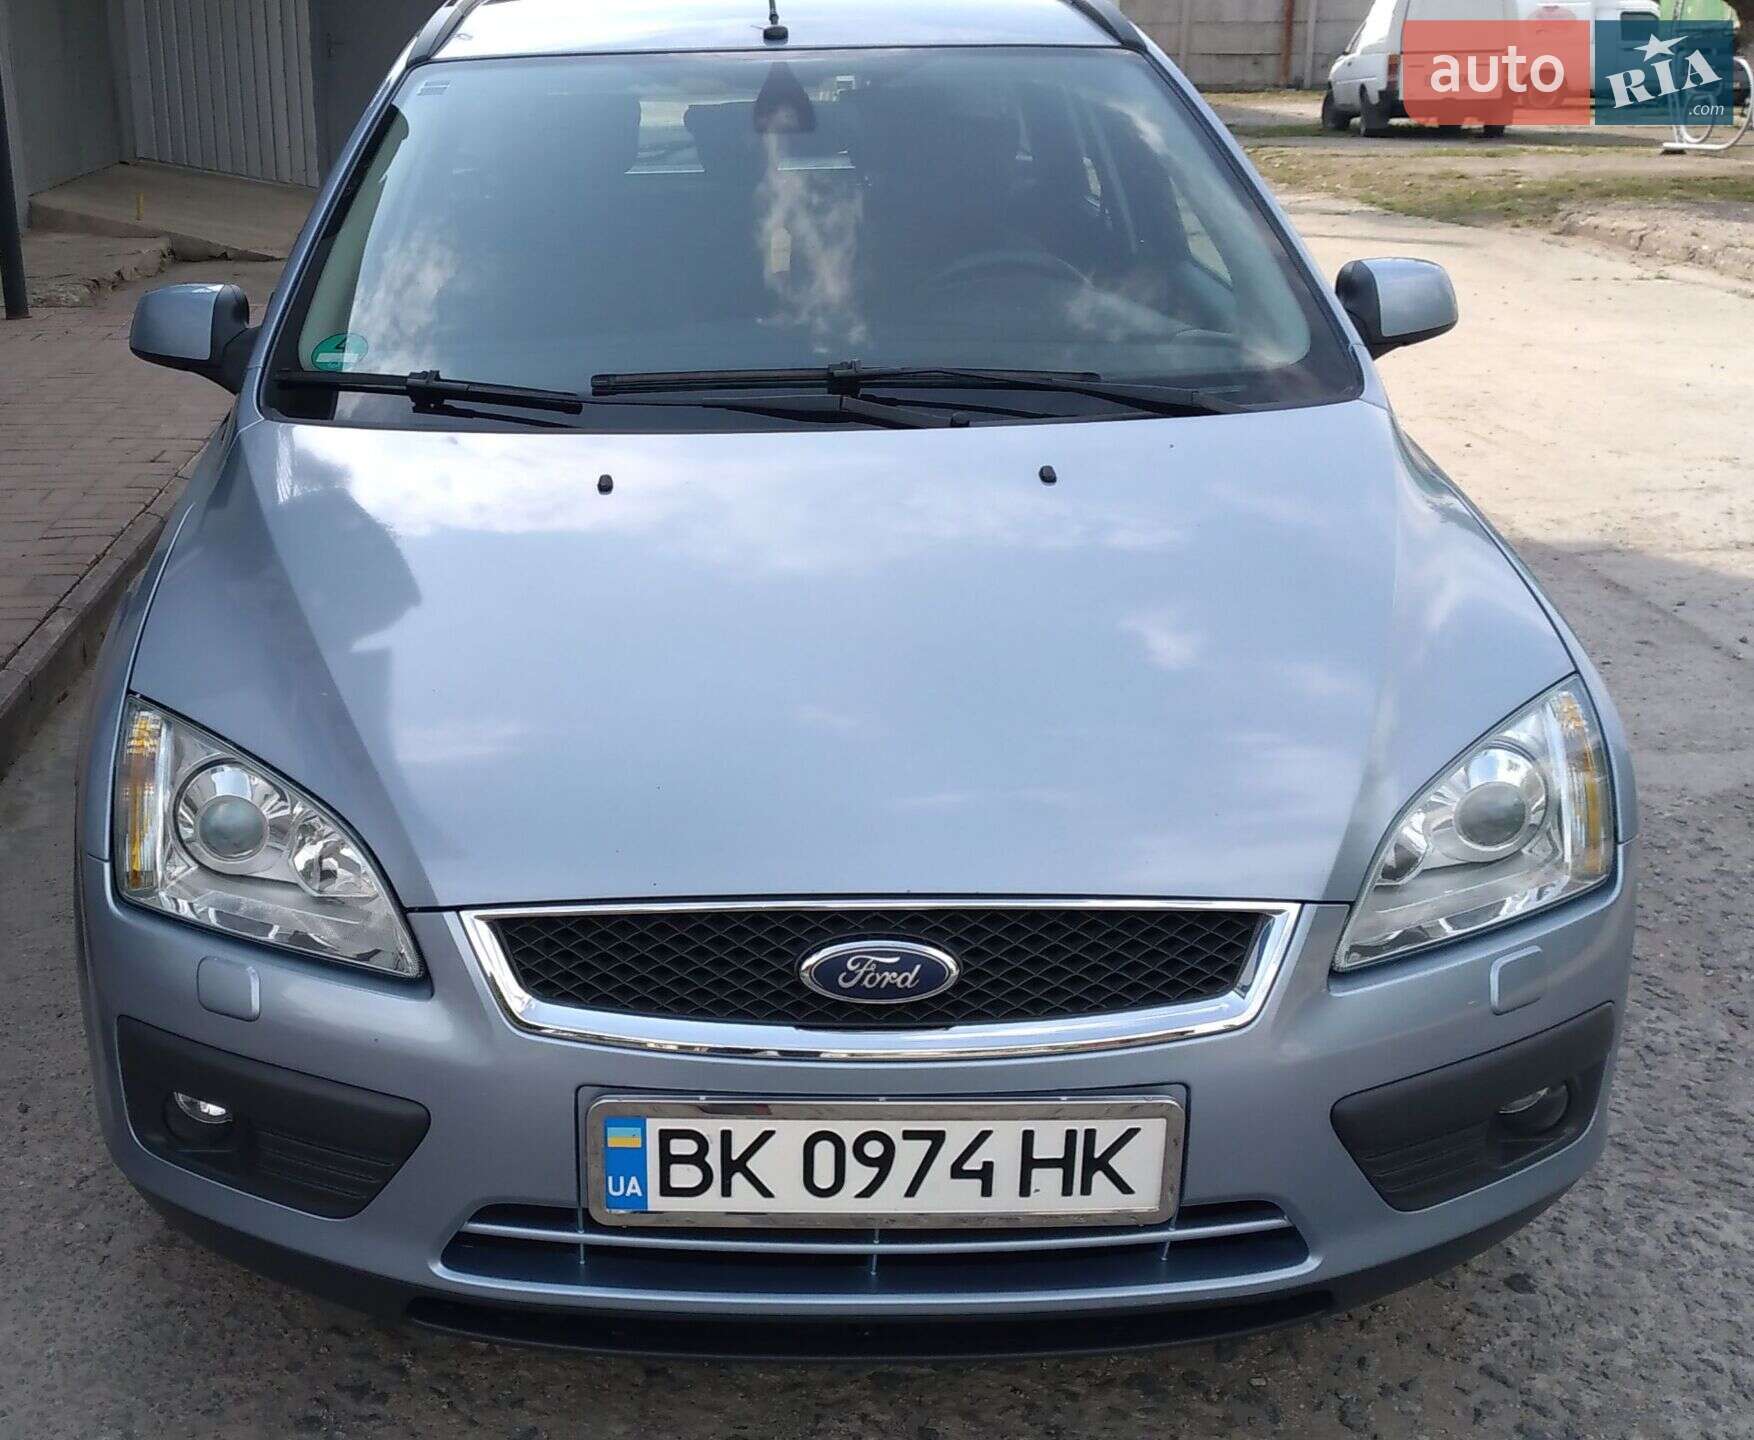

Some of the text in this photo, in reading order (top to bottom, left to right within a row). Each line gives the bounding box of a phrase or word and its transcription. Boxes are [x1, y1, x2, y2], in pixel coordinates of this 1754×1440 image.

[838, 955, 921, 988] Ford
[658, 1127, 1143, 1199] BK 0974 HK
[607, 1177, 643, 1197] UA
